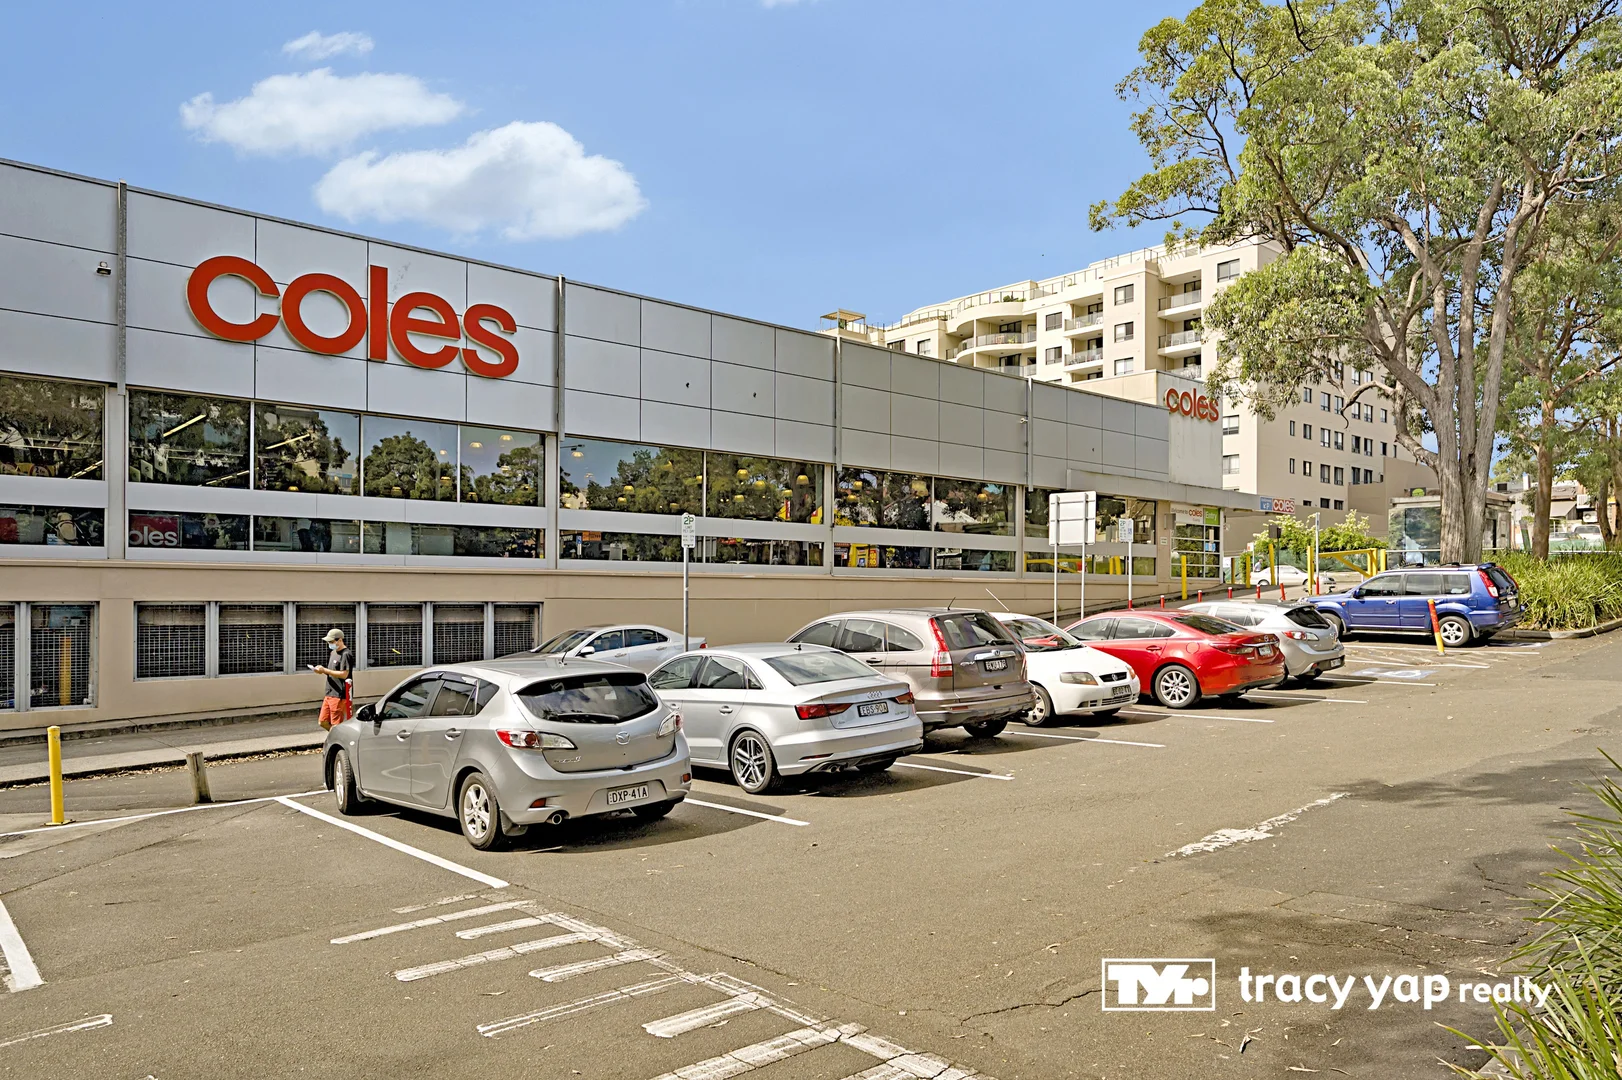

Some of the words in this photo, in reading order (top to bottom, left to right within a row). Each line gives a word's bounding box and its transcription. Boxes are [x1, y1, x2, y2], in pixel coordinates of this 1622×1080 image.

[186, 255, 520, 378] coles
[1165, 388, 1219, 422] coles
[1273, 499, 1295, 512] coles
[129, 525, 178, 547] oles
